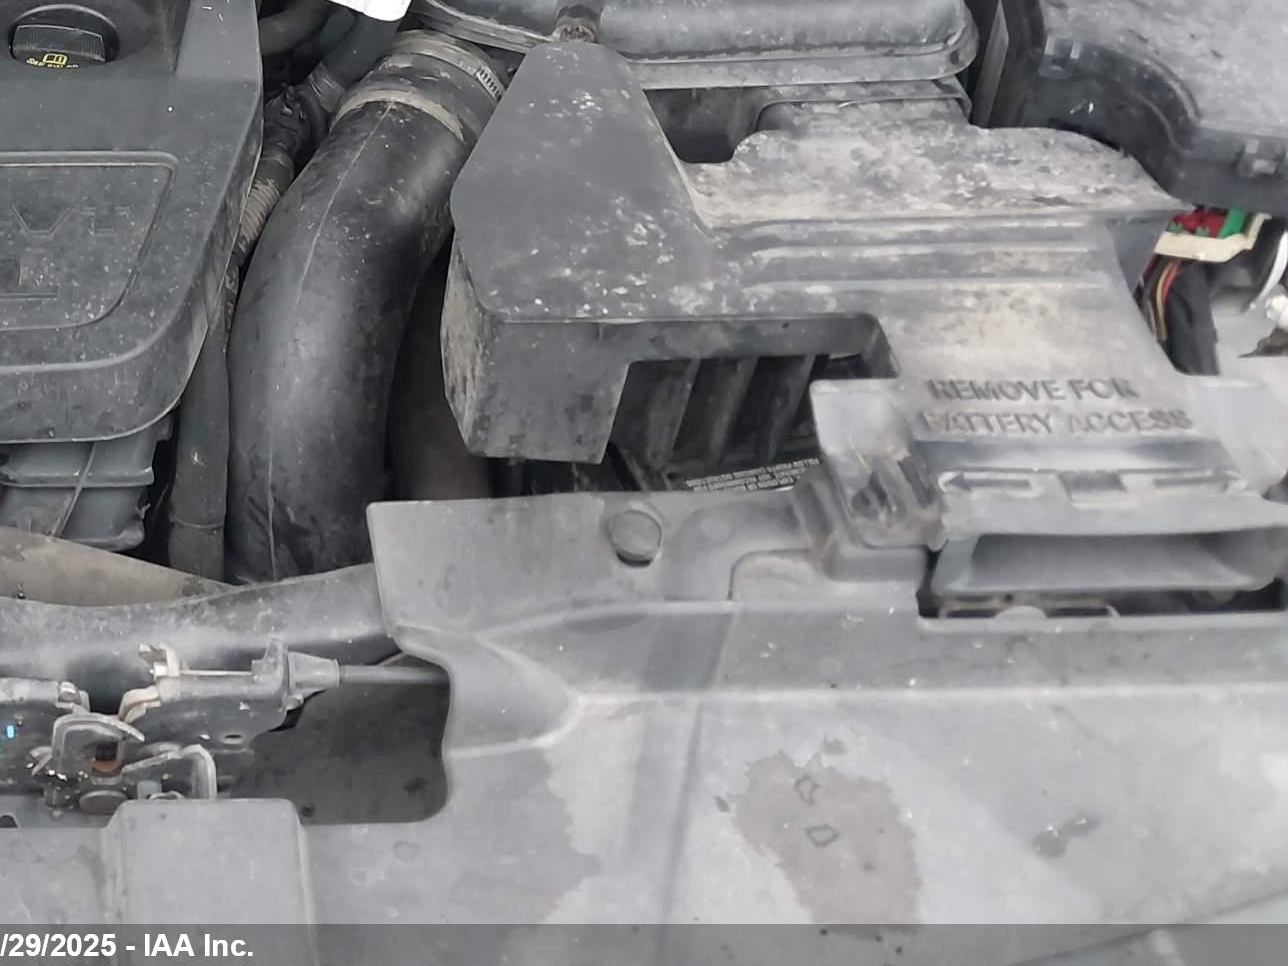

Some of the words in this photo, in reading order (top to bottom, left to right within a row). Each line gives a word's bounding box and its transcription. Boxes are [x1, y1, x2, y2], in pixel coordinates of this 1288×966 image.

[926, 377, 1065, 401] REMOVE
[1069, 376, 1140, 400] FOR
[918, 411, 1053, 434] BATTERY
[1067, 407, 1193, 434] ACCESS
